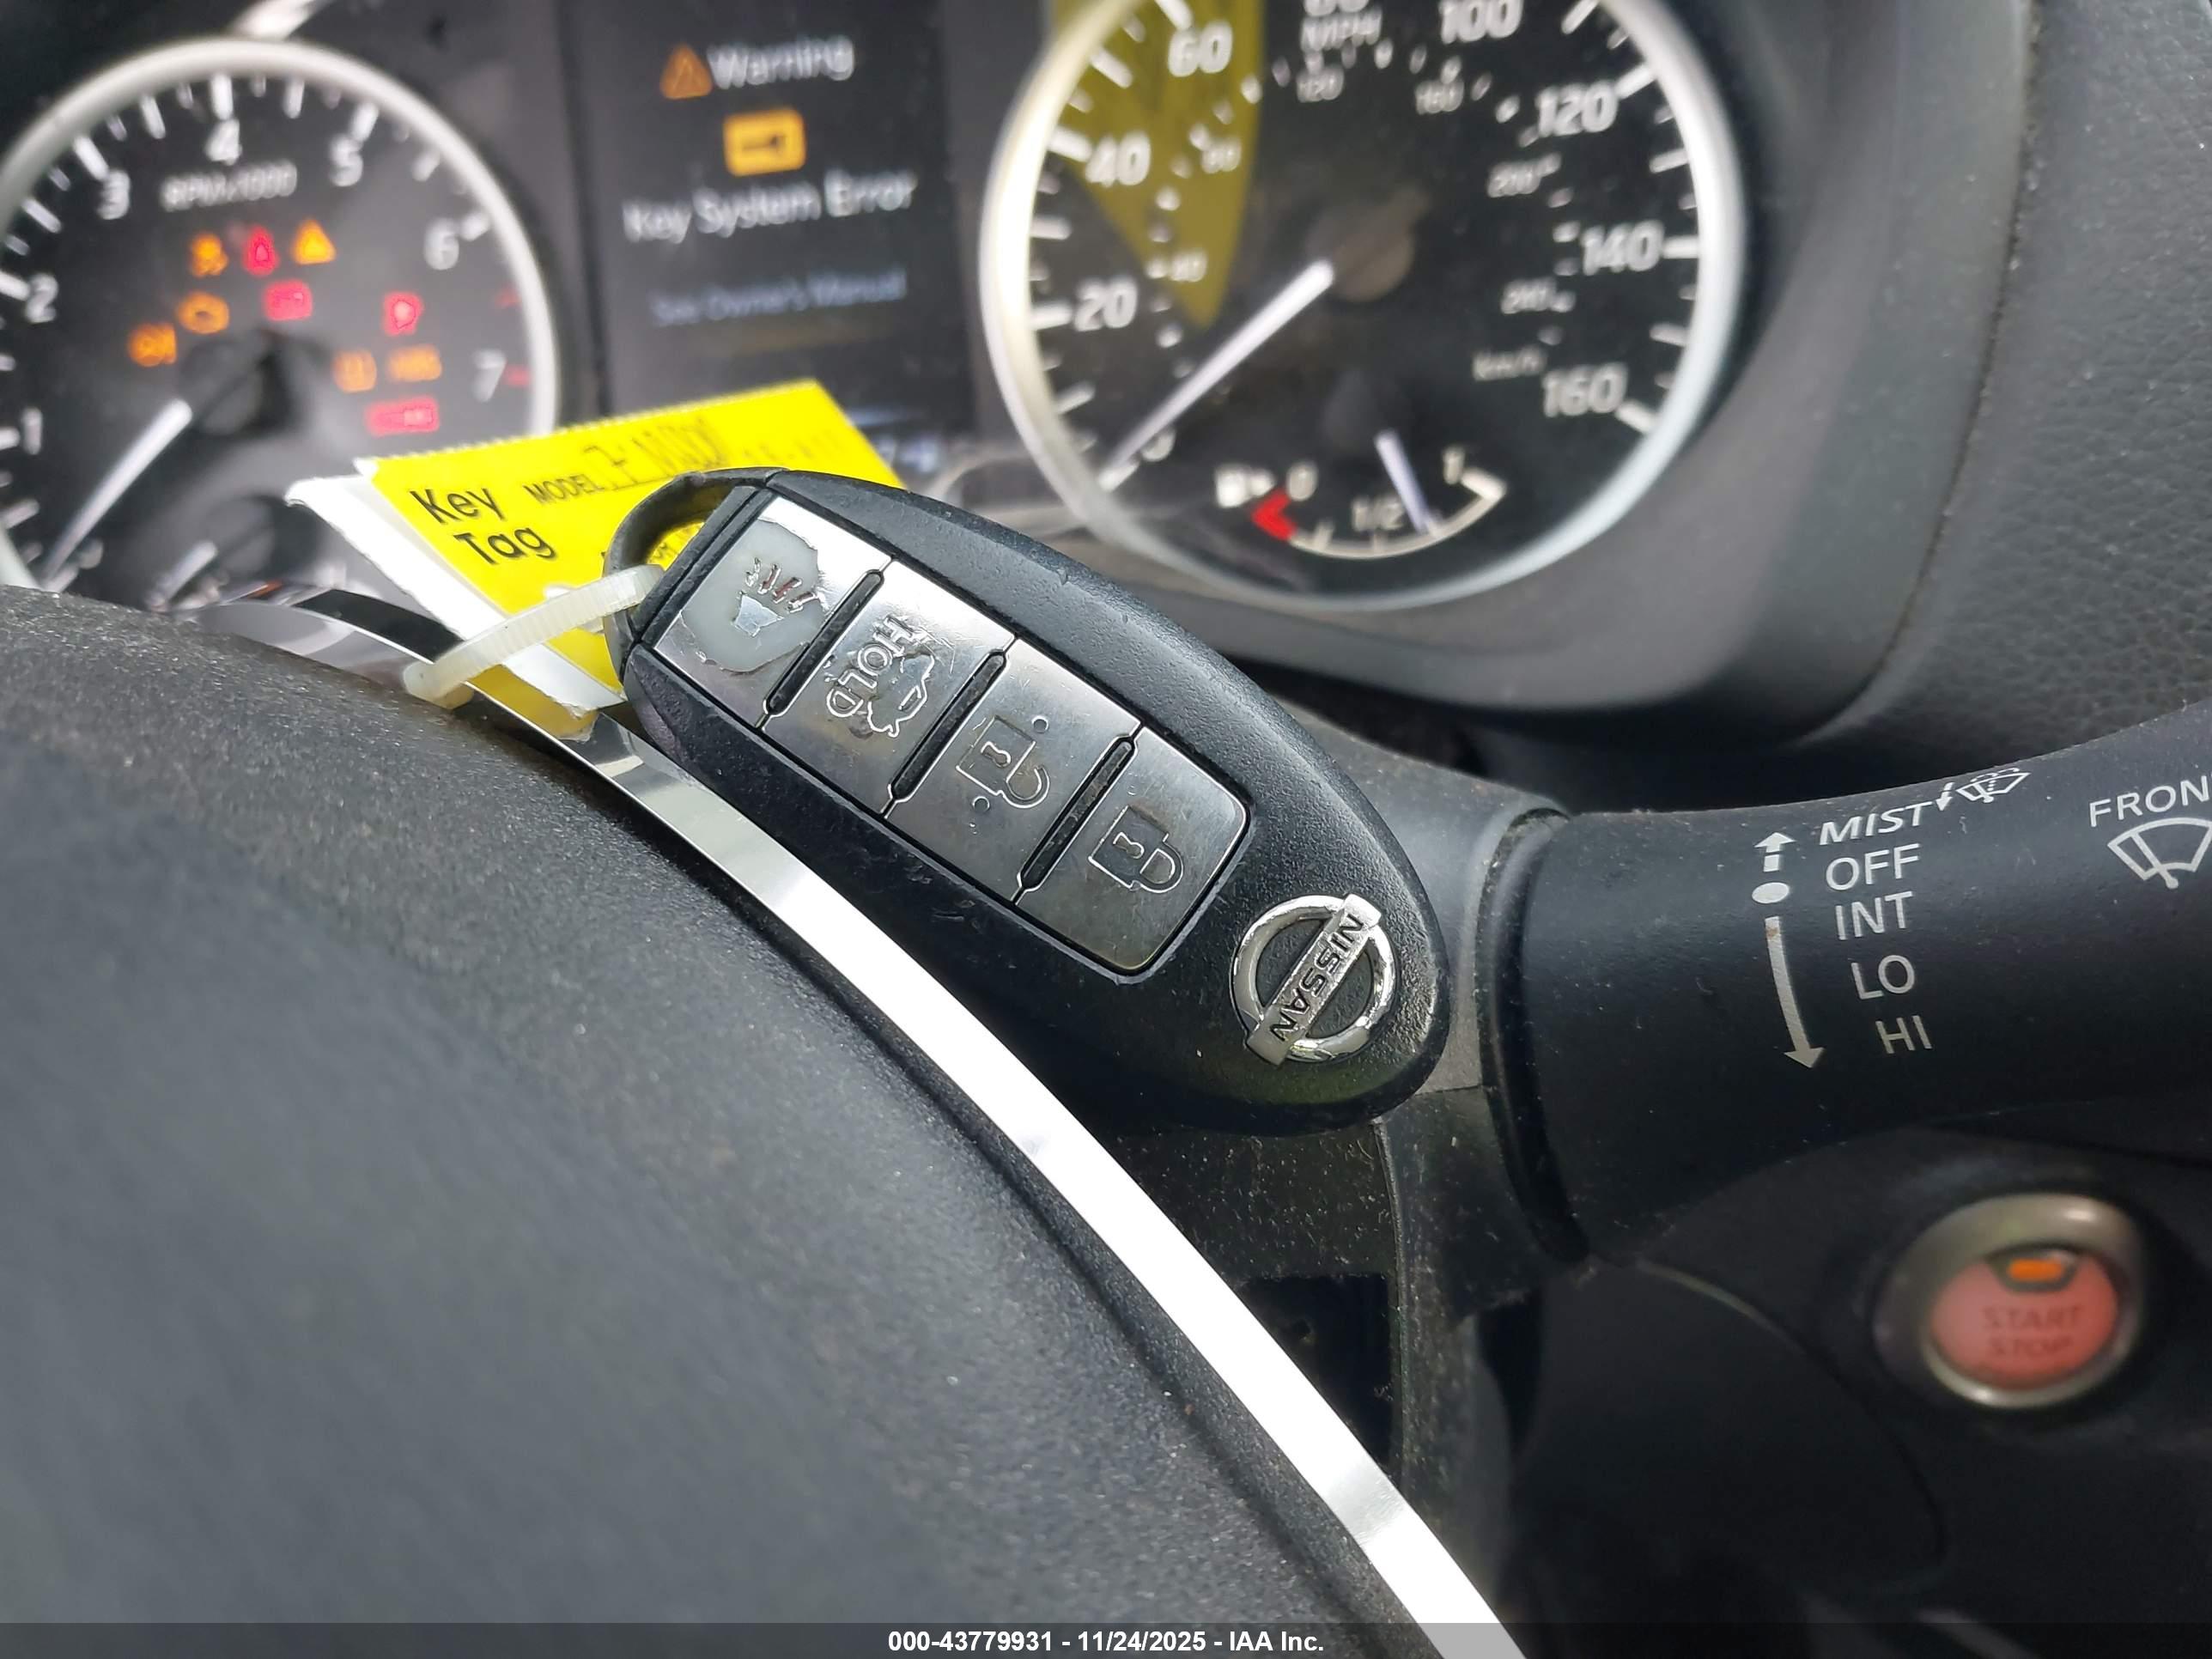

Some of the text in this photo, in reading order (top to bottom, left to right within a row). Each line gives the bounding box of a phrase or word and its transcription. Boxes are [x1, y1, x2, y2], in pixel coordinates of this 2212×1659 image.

[1437, 0, 1522, 43] 100
[707, 34, 855, 88] Warning
[1168, 21, 1232, 77] 60
[1537, 79, 1618, 137] 120
[206, 118, 241, 165] 4
[329, 131, 364, 186] 5
[1085, 131, 1151, 187] 40
[99, 170, 130, 220] 3
[622, 167, 917, 243] Key System Error
[424, 218, 459, 270] 6
[1580, 220, 1664, 275] 140
[23, 272, 58, 324] 2
[1074, 275, 1138, 331] 20
[472, 348, 507, 402] 7
[1543, 361, 1630, 418] 160
[22, 407, 43, 455] 1
[410, 488, 505, 525] Key
[523, 473, 605, 505] MODEL
[453, 527, 558, 565] Tag
[827, 616, 915, 718] HOLD
[1819, 801, 1933, 846] MIST
[2089, 773, 2212, 827] FRON
[1826, 843, 1920, 890] OFF
[1835, 891, 1914, 940] INT
[1269, 913, 1364, 1042] NISSAN
[1850, 955, 1915, 1000] LO
[1875, 1016, 1932, 1054] HI
[1983, 1304, 2084, 1332] START
